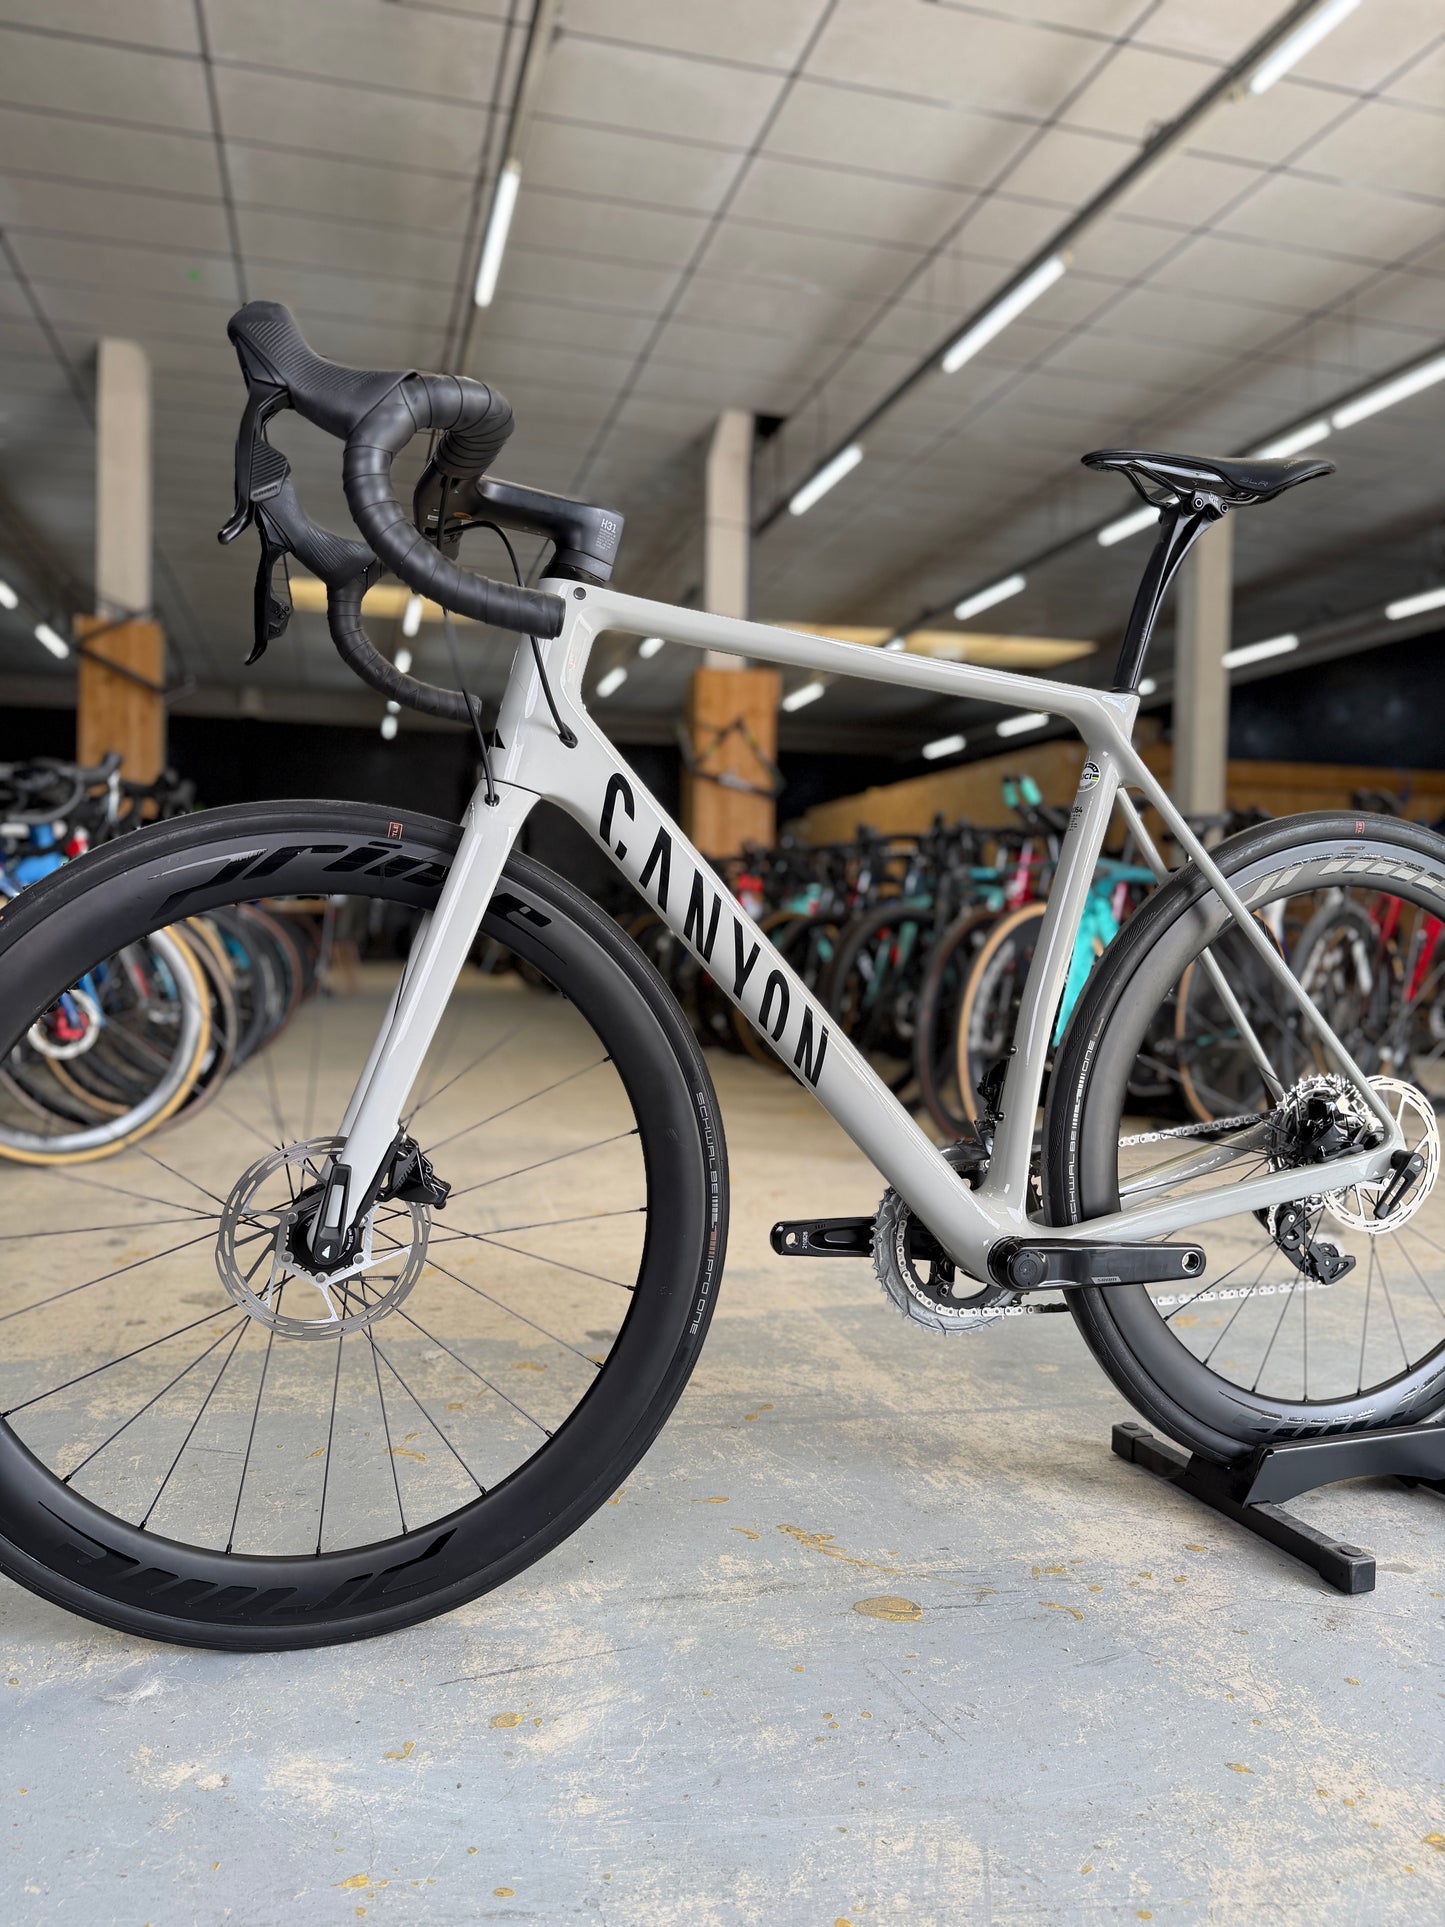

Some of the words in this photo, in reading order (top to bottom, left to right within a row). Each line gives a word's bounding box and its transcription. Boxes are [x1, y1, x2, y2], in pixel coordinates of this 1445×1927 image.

[600, 518, 617, 534] H31
[600, 773, 829, 1088] CANYON
[695, 1091, 719, 1194] SCHWALBE
